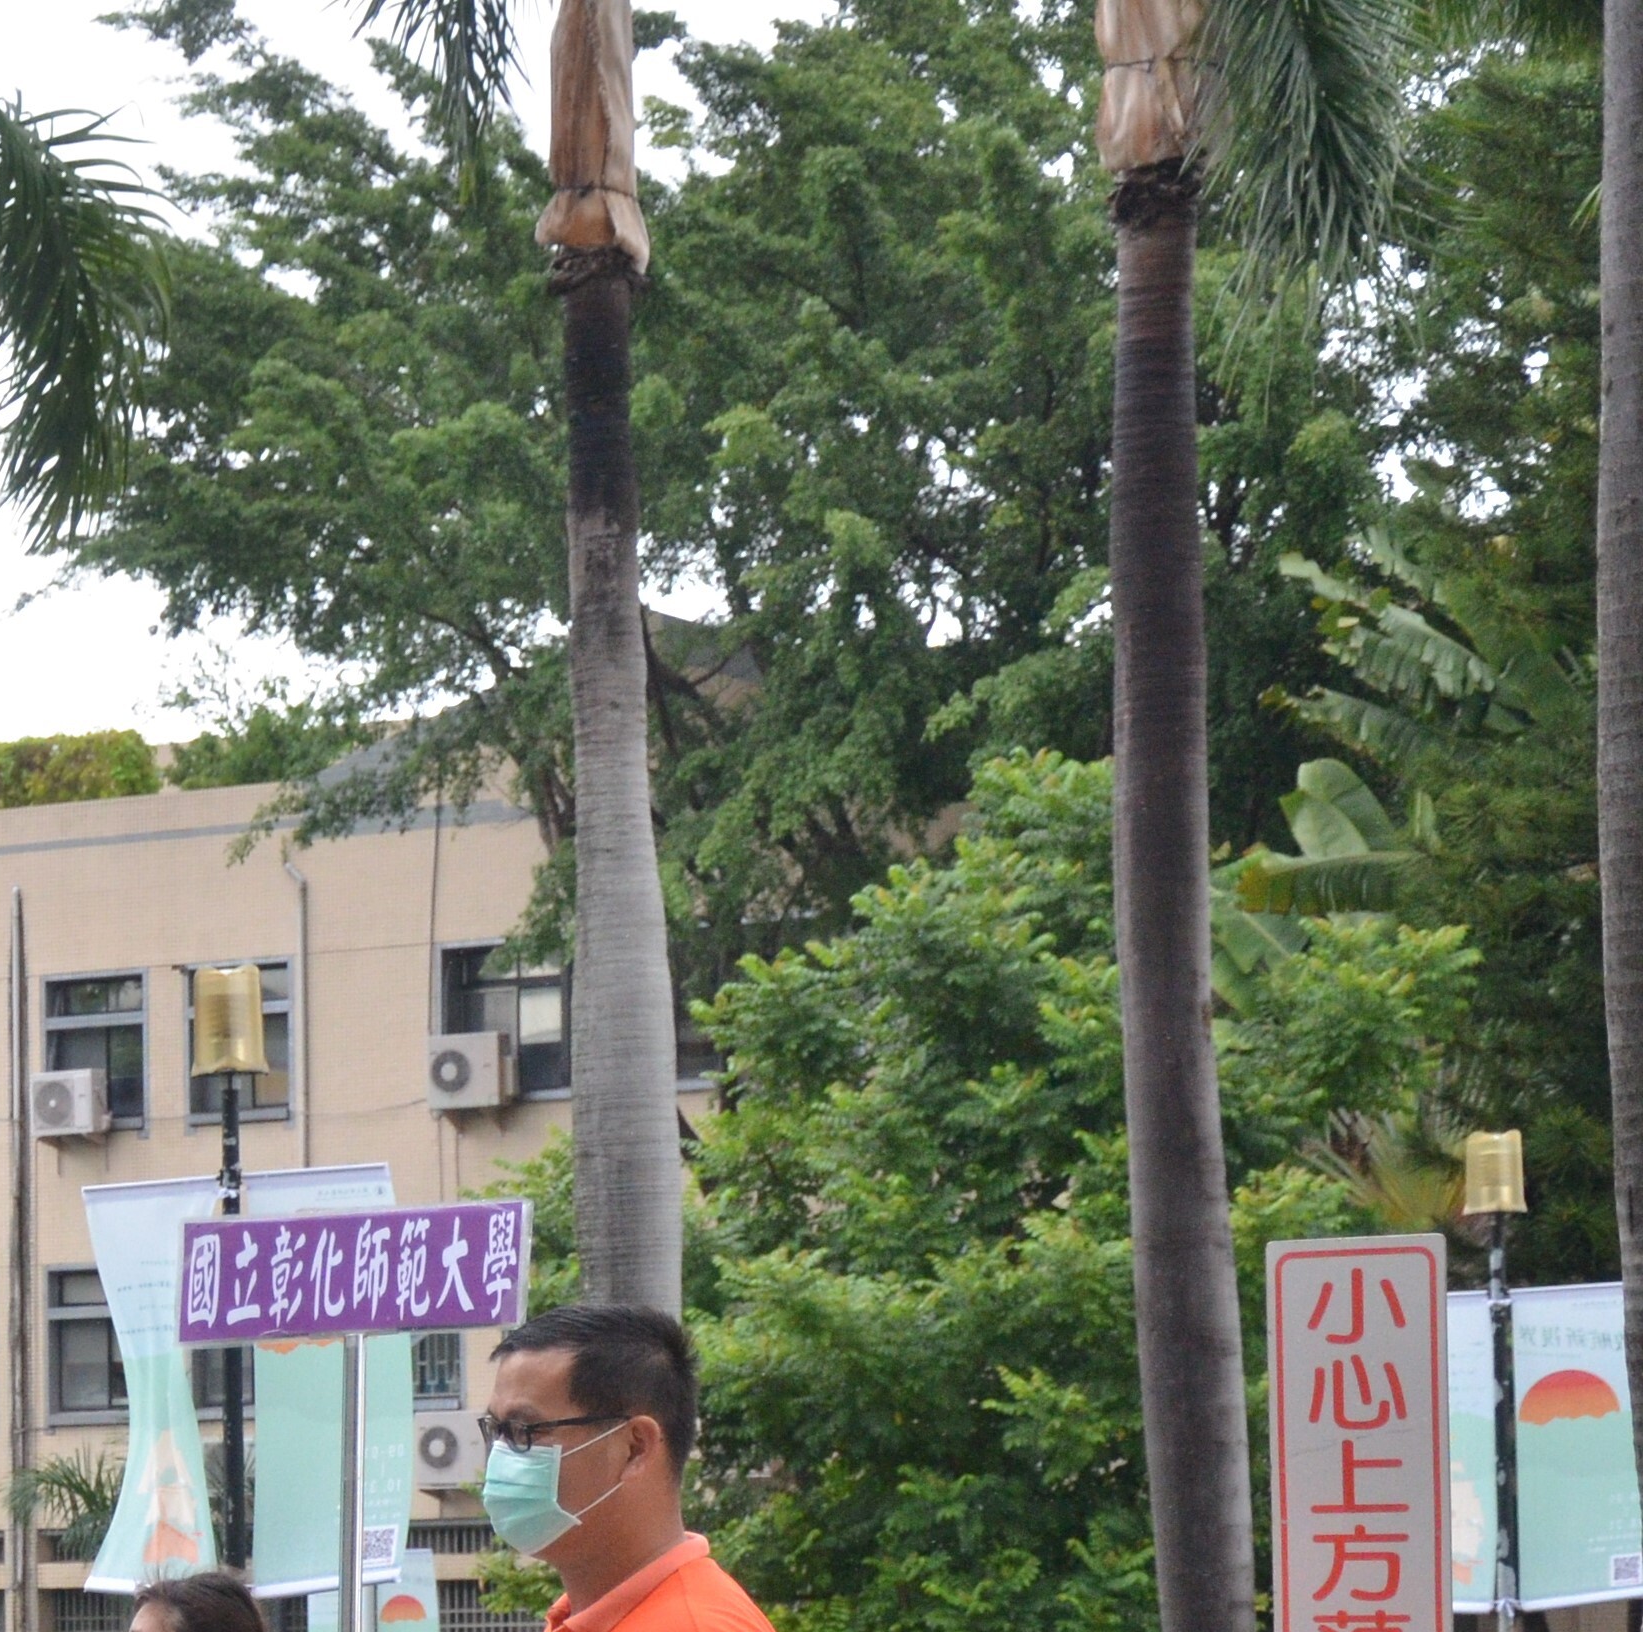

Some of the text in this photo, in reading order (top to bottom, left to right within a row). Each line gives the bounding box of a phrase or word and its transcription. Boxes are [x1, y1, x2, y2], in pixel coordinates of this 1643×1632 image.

[185, 1209, 518, 1331] 國立彰化師範大學
